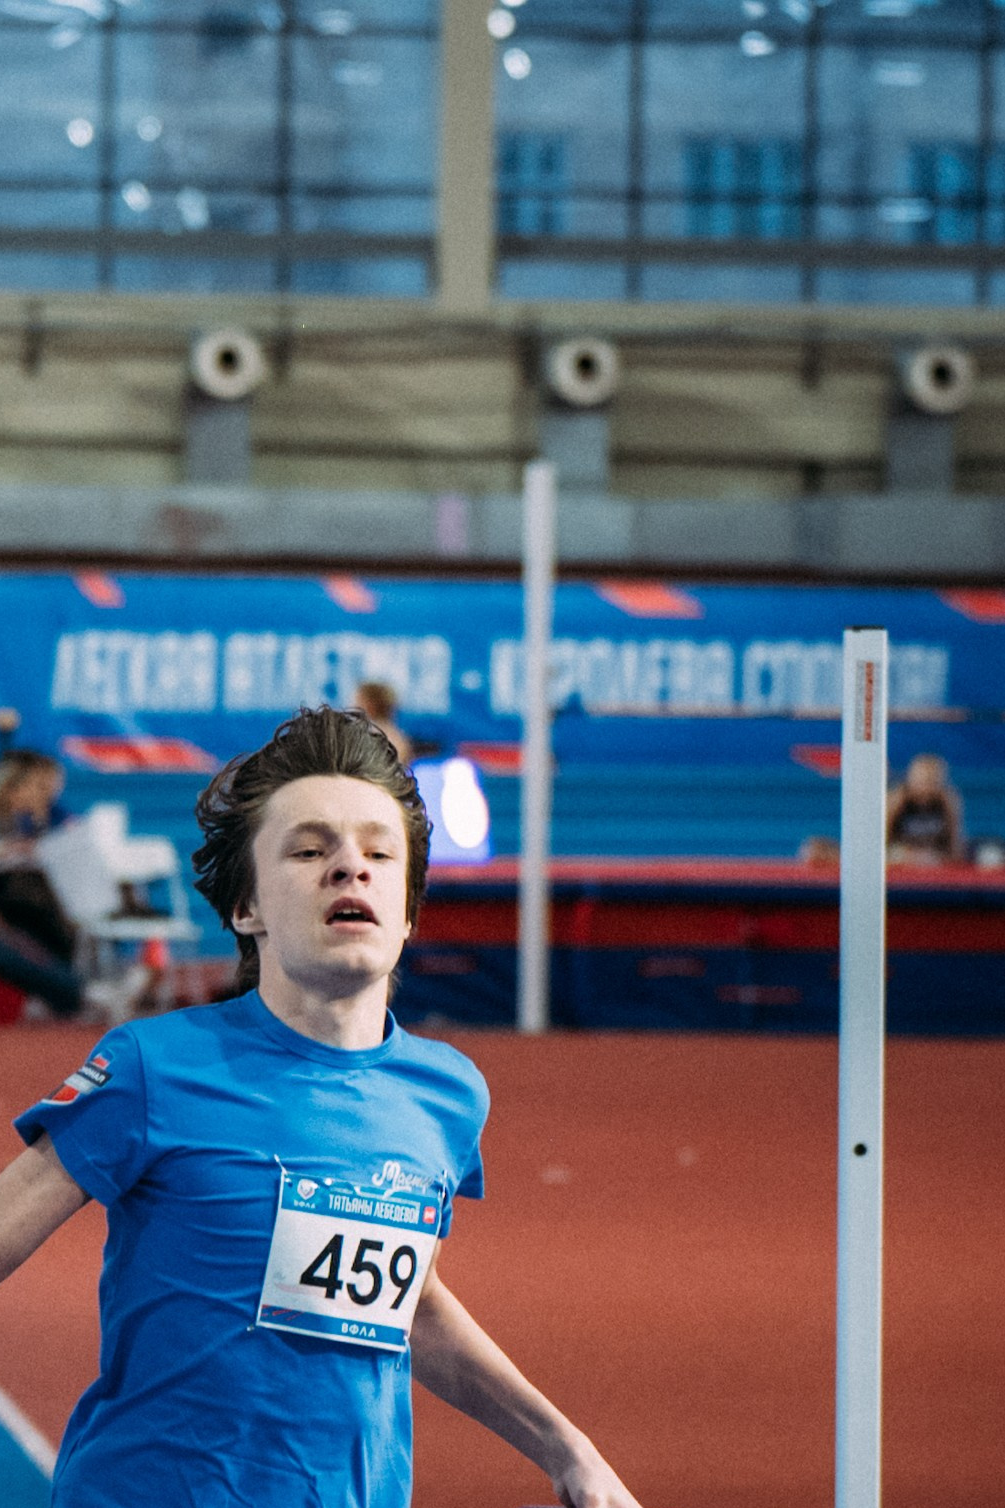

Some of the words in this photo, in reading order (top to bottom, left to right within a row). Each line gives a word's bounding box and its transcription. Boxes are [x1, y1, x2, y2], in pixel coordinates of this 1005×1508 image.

[329, 1193, 373, 1217] ТАТЬЯНЫ
[373, 1201, 420, 1225] ЛЕБЕДЕВОЙ
[299, 1233, 418, 1310] 459
[341, 1322, 376, 1338] ВФЛА
